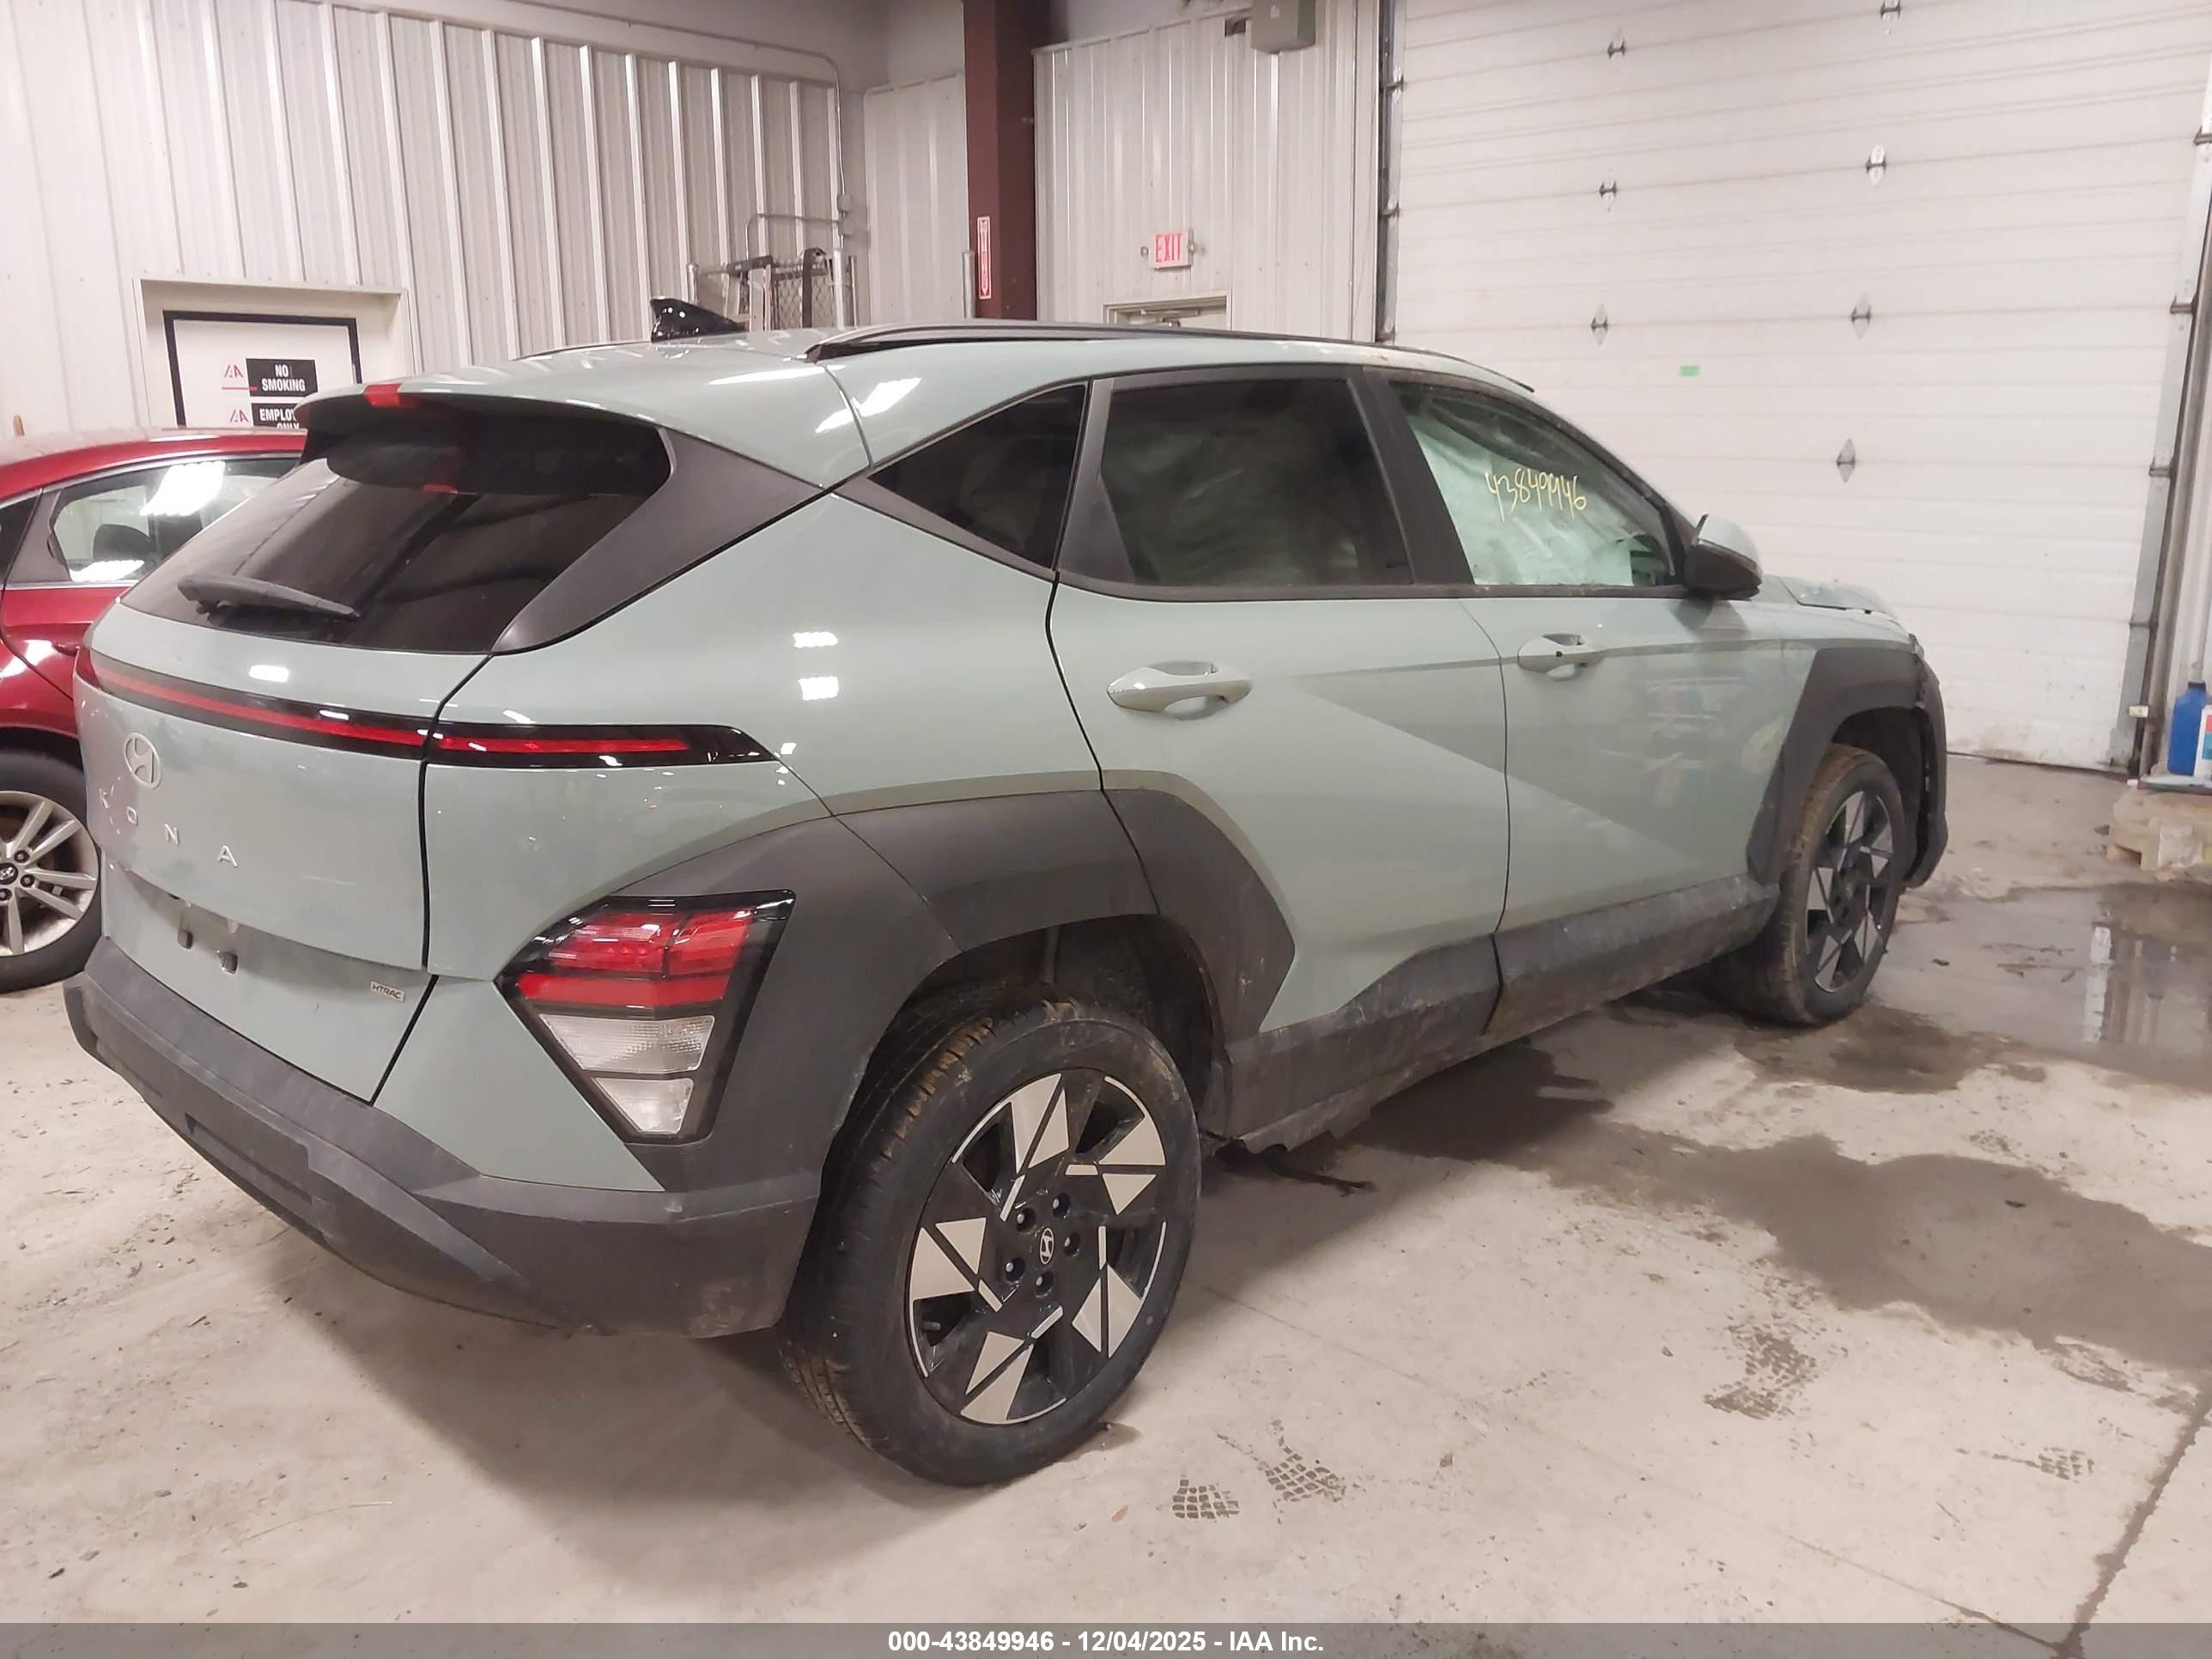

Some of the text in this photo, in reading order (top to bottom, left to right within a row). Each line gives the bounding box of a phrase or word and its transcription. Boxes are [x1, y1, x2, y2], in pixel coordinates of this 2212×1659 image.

[1155, 233, 1182, 263] EXIT
[275, 364, 289, 378] NO
[261, 378, 307, 392] SMOKING
[1484, 468, 1588, 523] 43849946
[98, 785, 239, 868] KONA
[372, 983, 403, 1000] HTRAC
